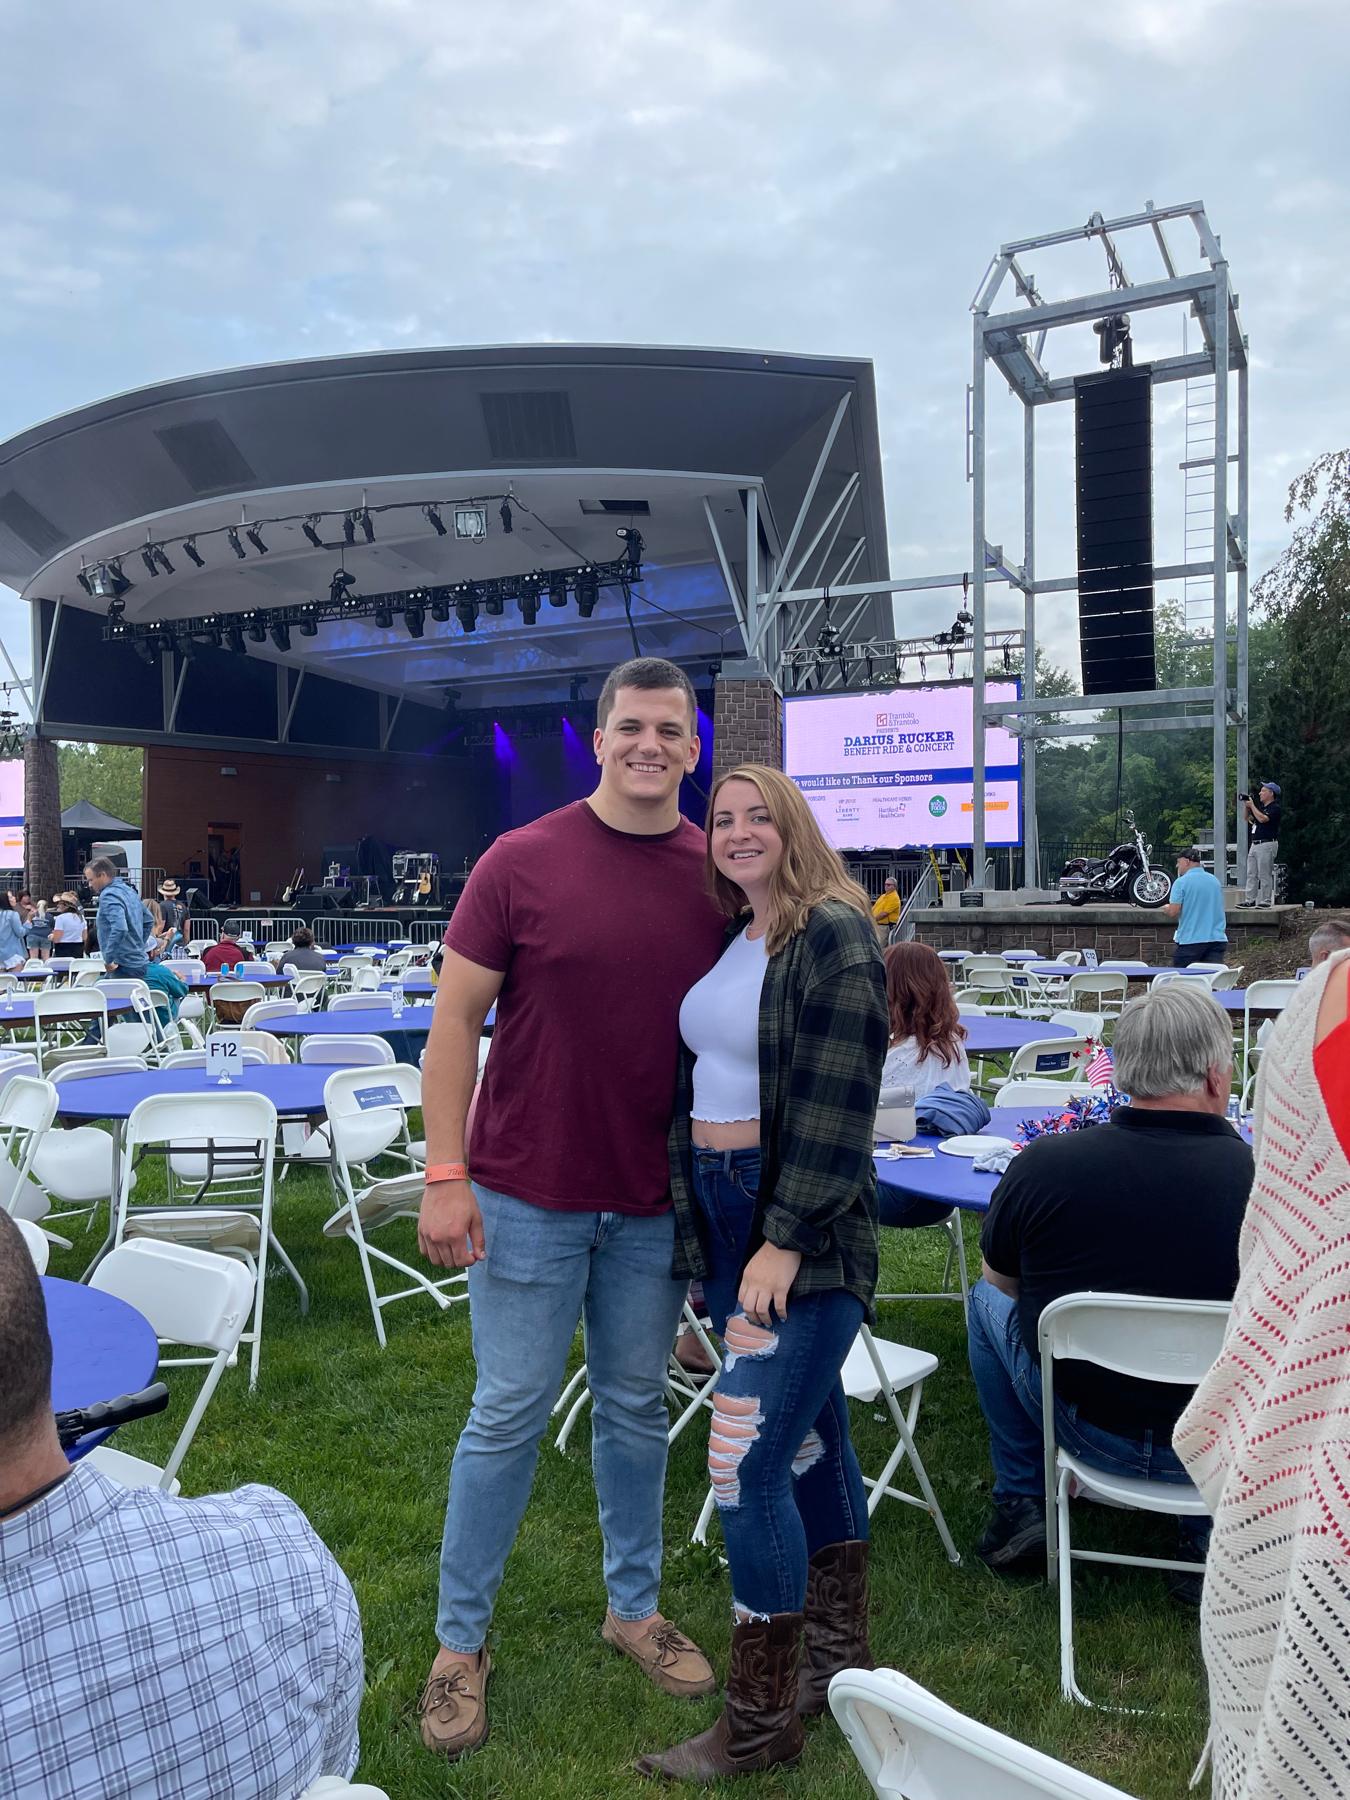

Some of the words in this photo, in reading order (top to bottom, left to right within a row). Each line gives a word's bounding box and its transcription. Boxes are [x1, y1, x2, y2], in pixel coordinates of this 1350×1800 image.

[888, 712, 914, 720] Trantolo
[844, 735, 894, 747] DARIUS
[898, 730, 954, 744] RUCKER
[844, 746, 881, 756] BENEFIT
[882, 745, 904, 754] RIDE
[906, 744, 912, 753] &
[914, 742, 954, 752] CONCERT
[801, 778, 824, 787] would
[826, 776, 840, 786] like
[842, 776, 850, 785] to
[852, 774, 878, 785] Thank
[878, 774, 894, 784] our
[894, 773, 933, 784] Sponsors
[1086, 952, 1096, 960] C12
[392, 991, 402, 1000] E10
[210, 1042, 238, 1057] F12
